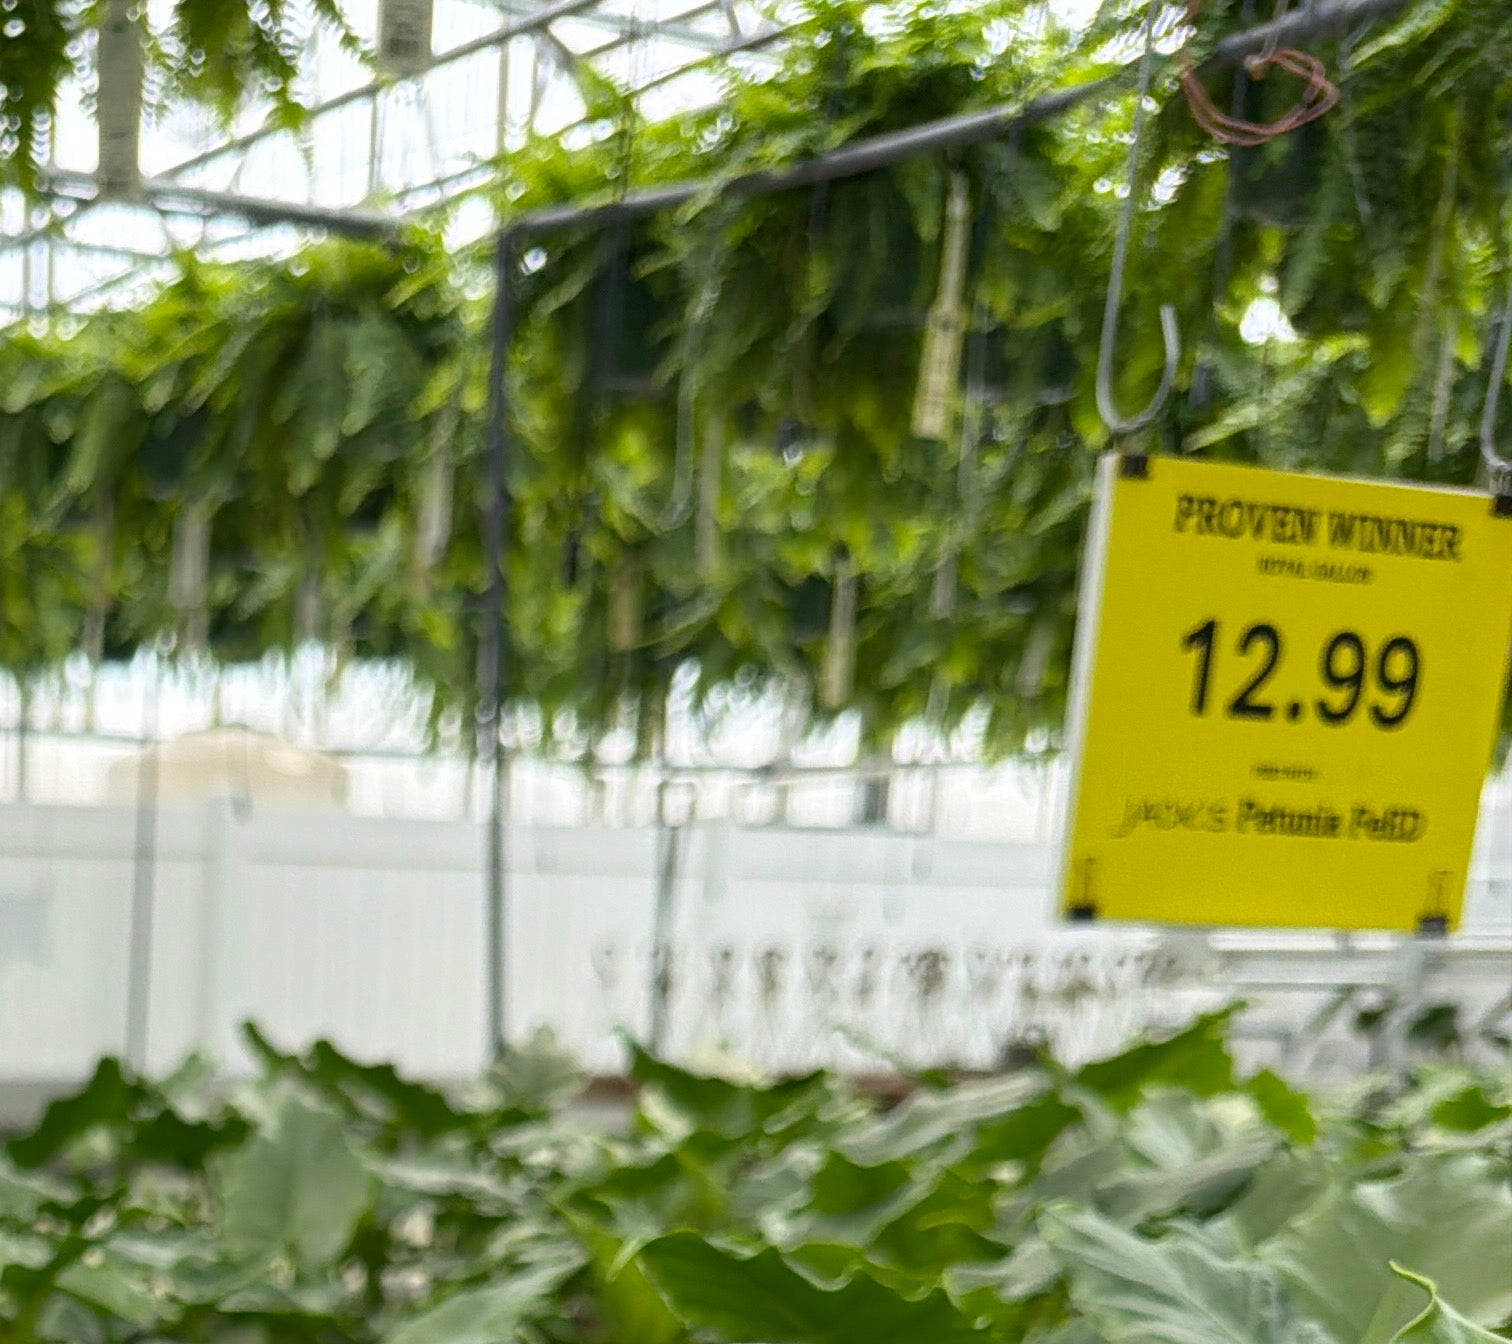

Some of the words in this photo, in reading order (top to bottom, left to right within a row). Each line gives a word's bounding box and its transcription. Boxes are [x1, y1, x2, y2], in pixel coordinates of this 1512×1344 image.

[1173, 494, 1320, 546] PROVEN
[1327, 510, 1462, 562] WINNER
[1181, 616, 1424, 731] 12.99
